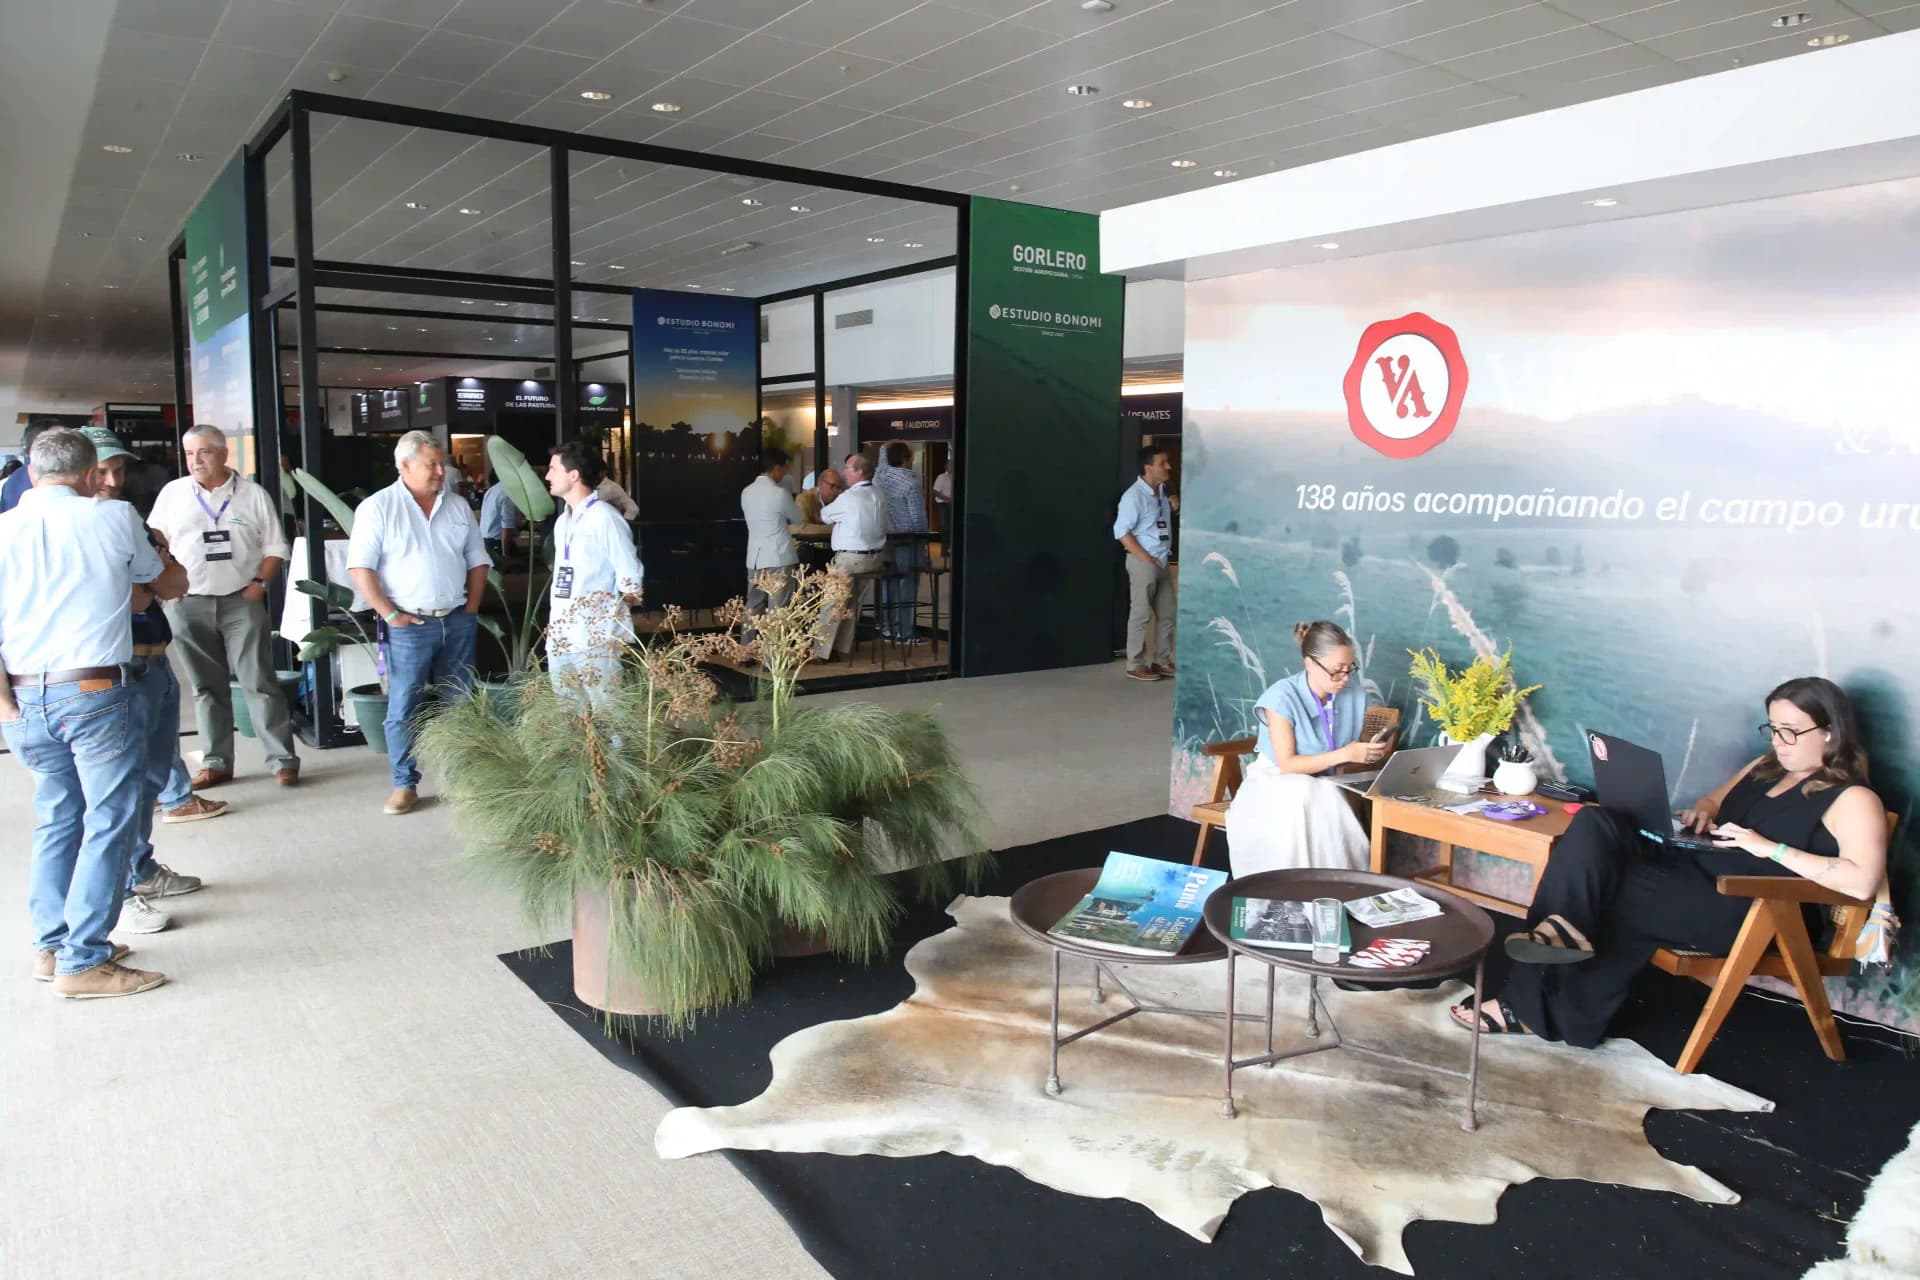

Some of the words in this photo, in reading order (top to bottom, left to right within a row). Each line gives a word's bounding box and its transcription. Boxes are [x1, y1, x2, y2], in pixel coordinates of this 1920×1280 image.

[1013, 245, 1086, 270] GORLERO
[666, 318, 700, 327] ESTUDIO
[702, 320, 735, 329] BONOMI
[1002, 307, 1051, 322] ESTUDIO
[1055, 313, 1102, 328] BONOMI
[1295, 484, 1336, 511] 138
[1342, 485, 1405, 512] años
[1413, 487, 1644, 522] acompañando
[1656, 490, 1690, 521] el
[1700, 498, 1844, 533] campo
